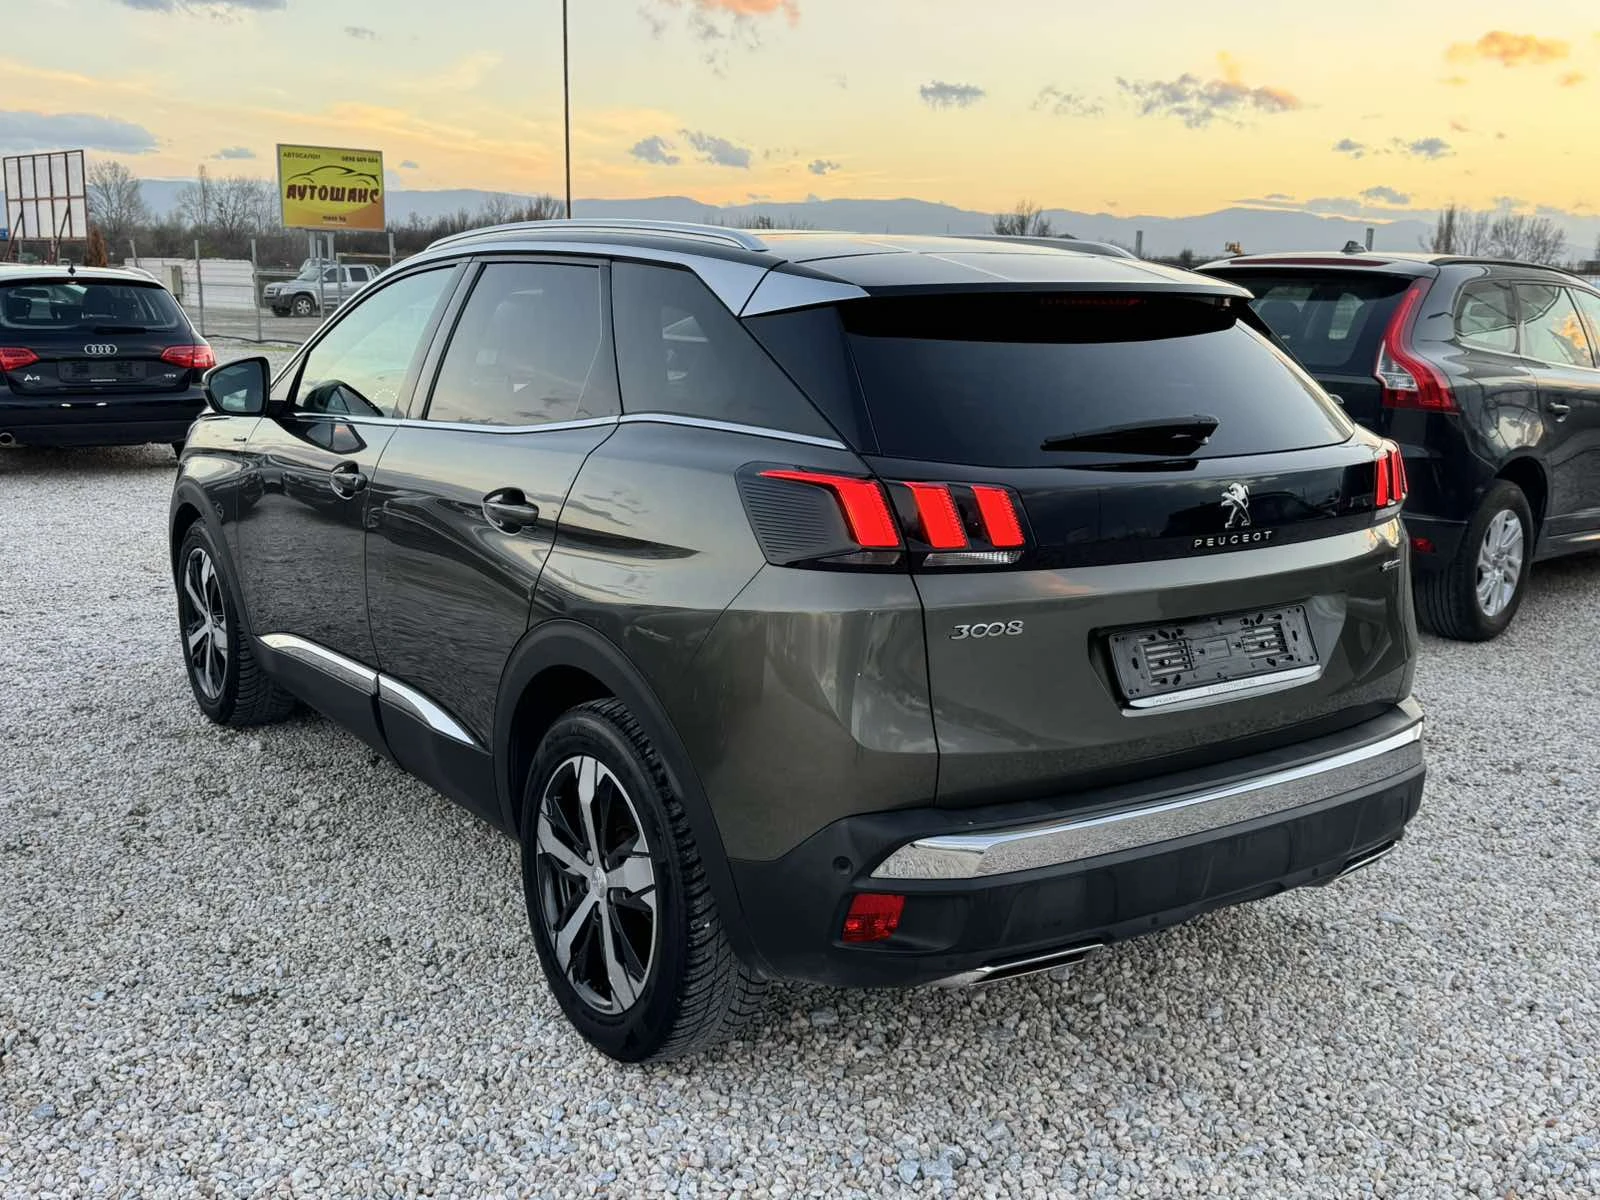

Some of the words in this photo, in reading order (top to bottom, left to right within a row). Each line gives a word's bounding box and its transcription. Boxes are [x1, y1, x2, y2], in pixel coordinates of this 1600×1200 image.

[286, 184, 380, 203] АУТОШАНС
[1193, 530, 1273, 548] PEUGEOT
[950, 619, 1025, 640] 3008
